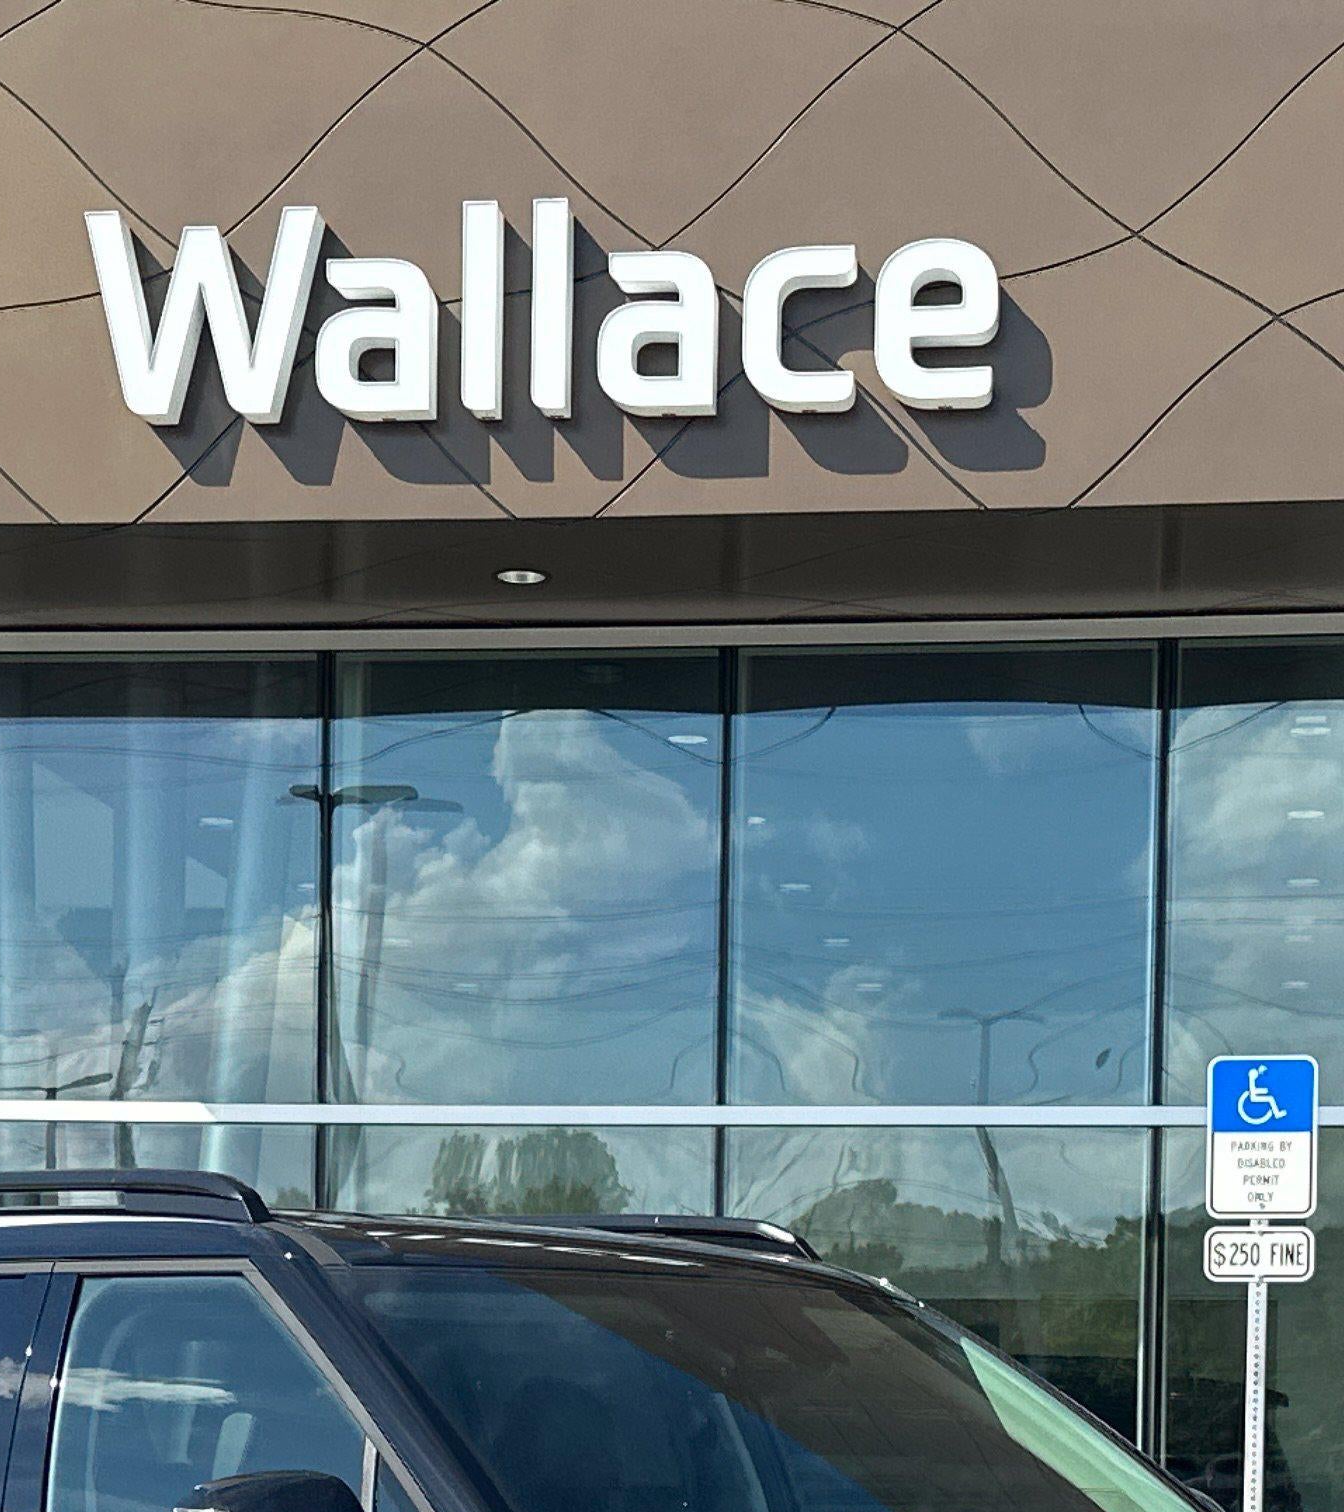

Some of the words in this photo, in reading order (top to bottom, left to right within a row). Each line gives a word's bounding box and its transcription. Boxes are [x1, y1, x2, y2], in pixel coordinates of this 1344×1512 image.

[85, 197, 1000, 426] Wallace
[1230, 1141, 1274, 1152] PARKING
[1279, 1141, 1293, 1152] BY
[1242, 1175, 1280, 1186] PERMIT
[1213, 1241, 1261, 1269] $250
[1270, 1242, 1305, 1267] FINE
